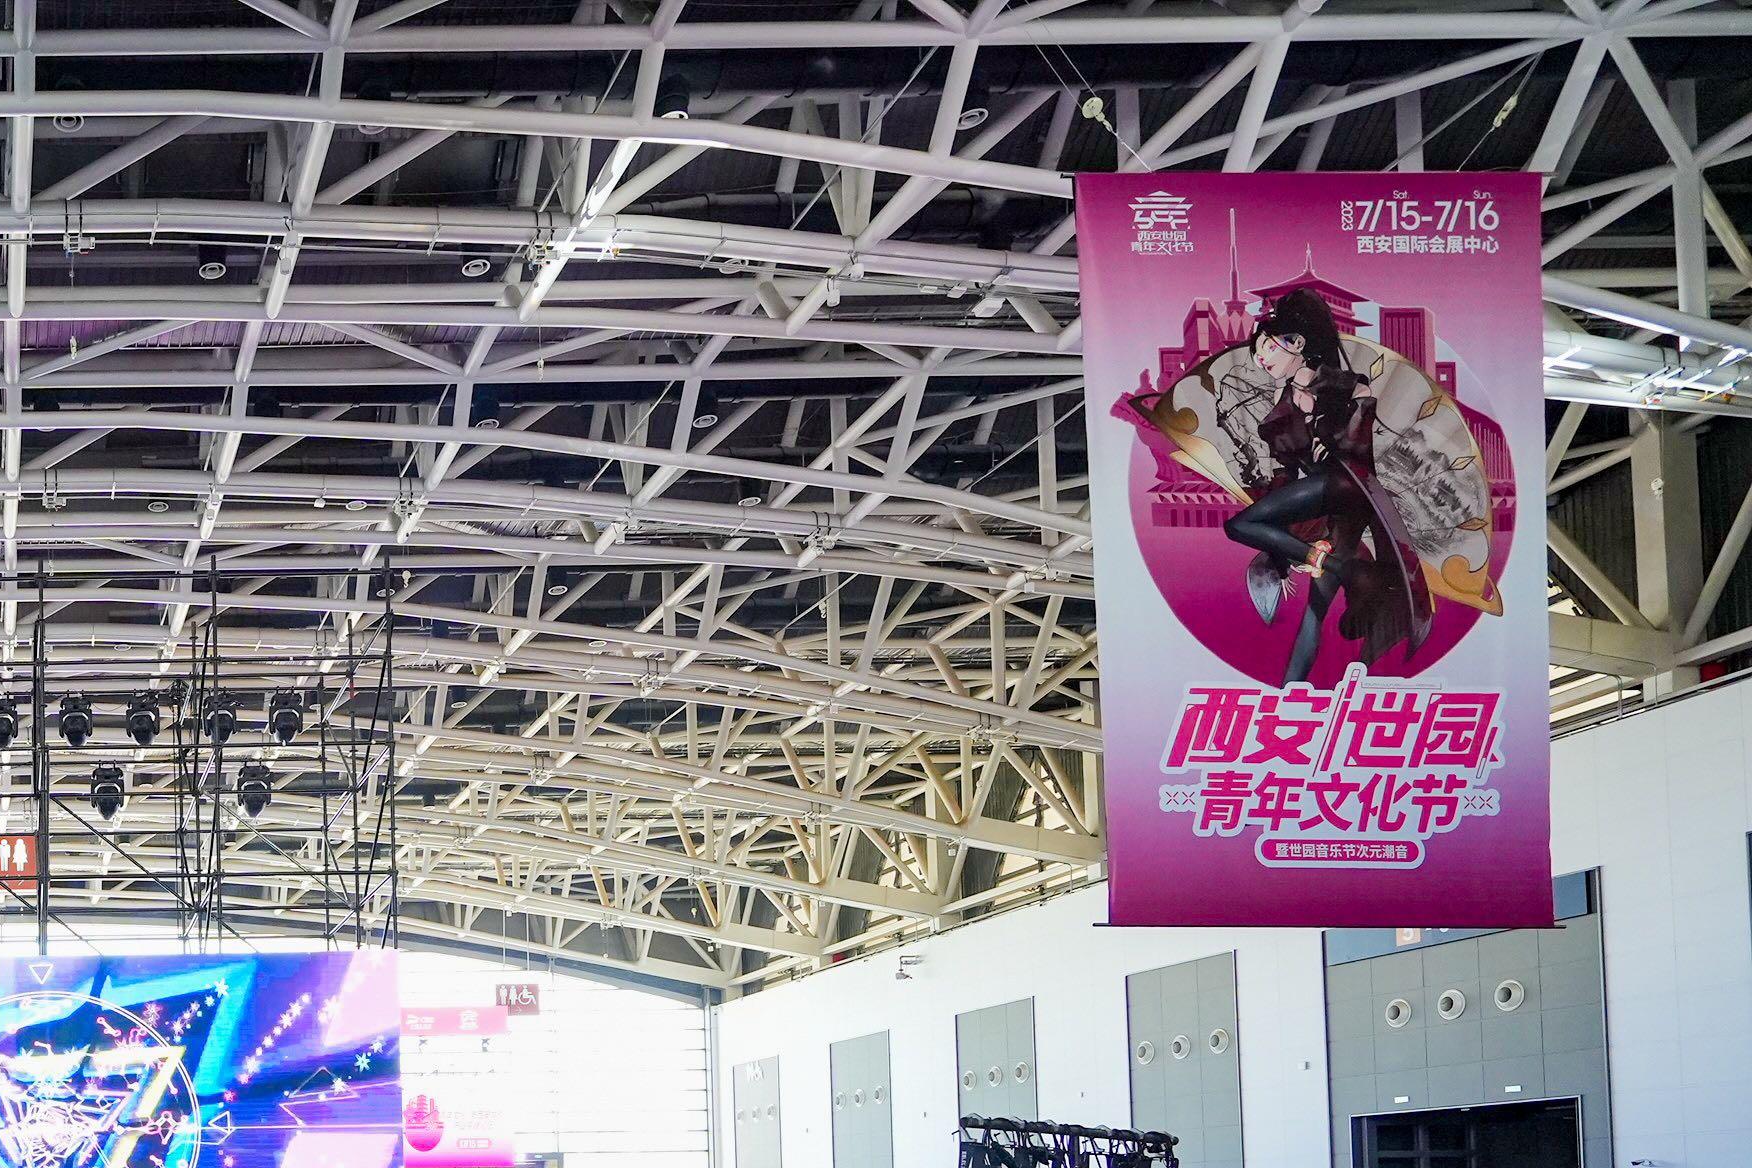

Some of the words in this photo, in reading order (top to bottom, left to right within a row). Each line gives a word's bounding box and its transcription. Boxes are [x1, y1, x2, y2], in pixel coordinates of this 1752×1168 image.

[1341, 200, 1353, 231] 2023
[1355, 199, 1499, 232] 7/15-7/16
[1357, 235, 1499, 254] 西安国际会展中心
[1200, 771, 1467, 833] 青年文化节
[1275, 842, 1408, 859] 暨世园音乐节次元潮音
